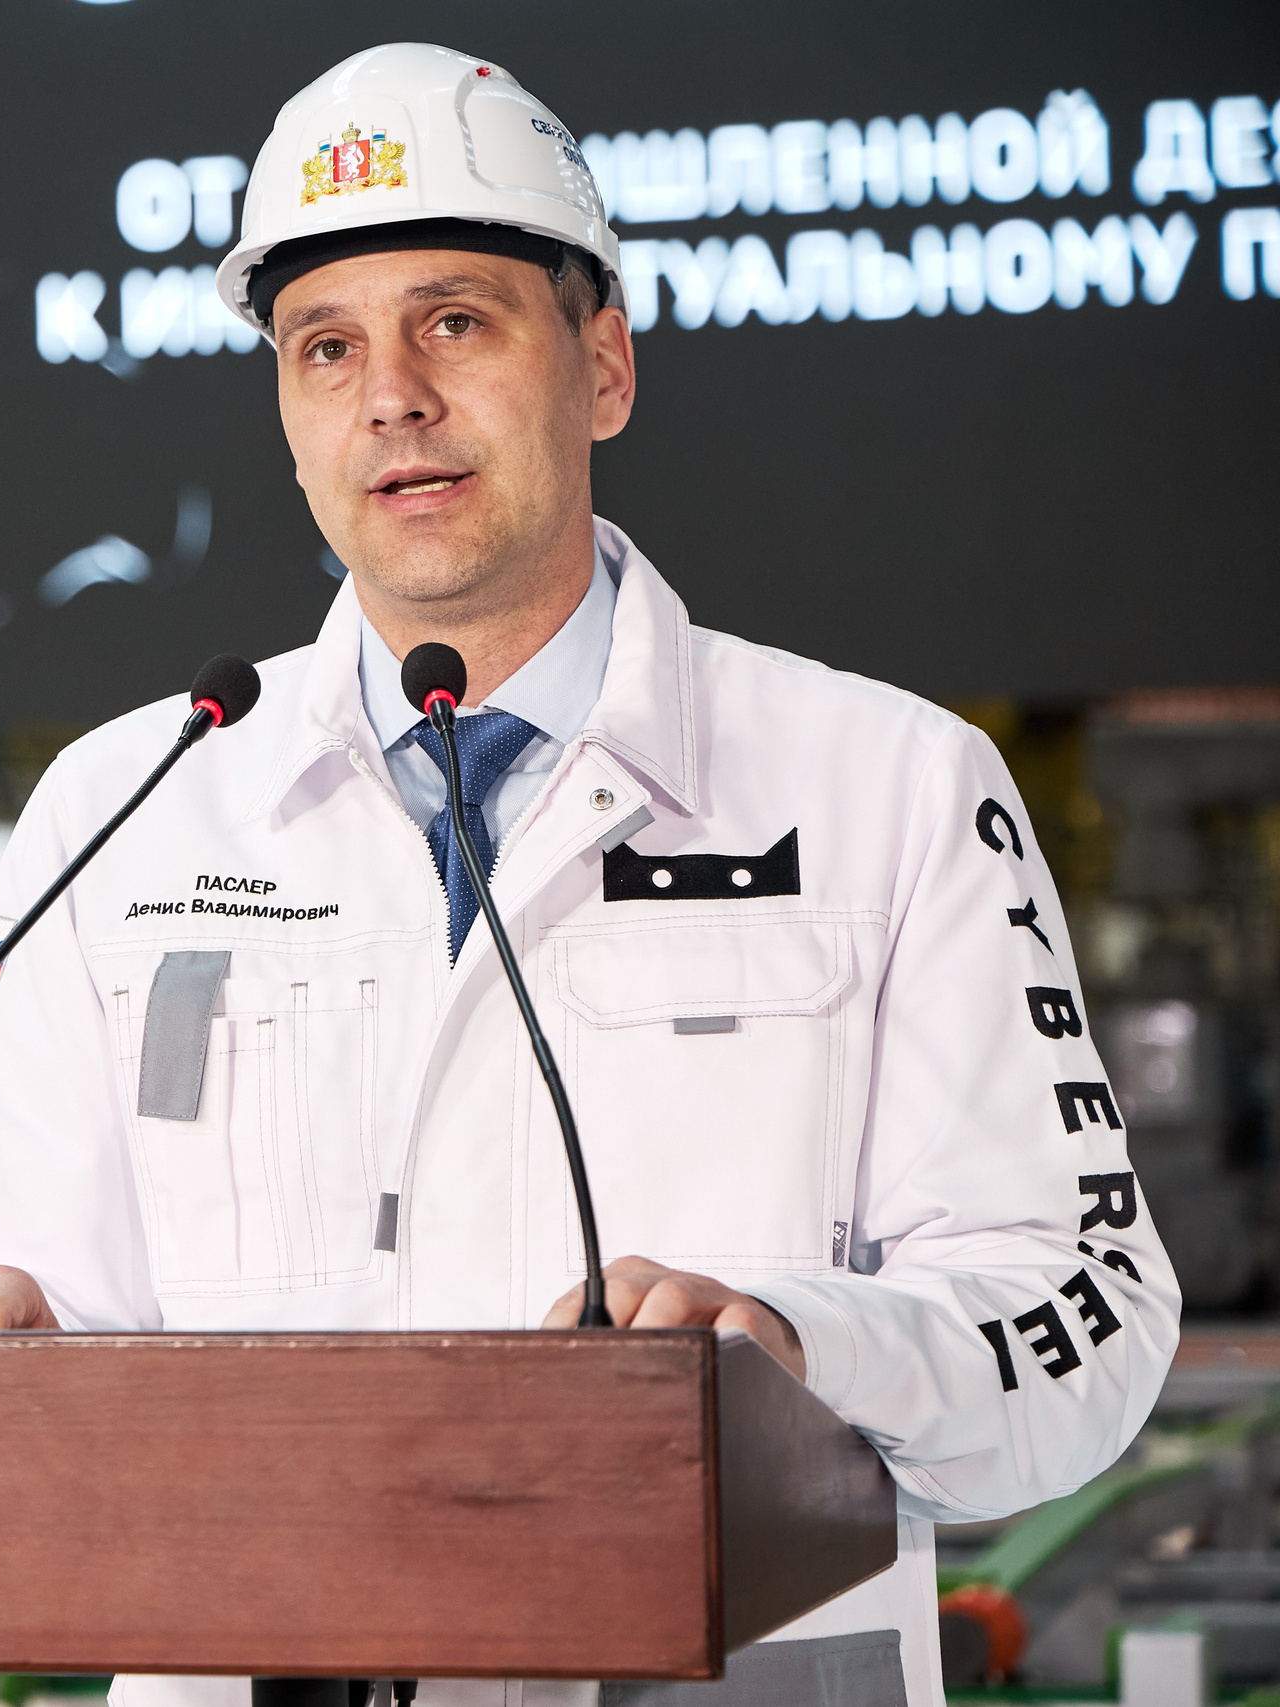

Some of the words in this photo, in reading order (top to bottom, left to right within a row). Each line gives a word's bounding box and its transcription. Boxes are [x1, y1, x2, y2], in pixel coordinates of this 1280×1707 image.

[116, 155, 249, 252] ОТ
[582, 87, 1111, 223] ШЛЕННОЙ
[1132, 95, 1280, 206] ДЕ
[36, 270, 108, 364] К
[124, 902, 185, 920] Денис
[191, 898, 339, 922] Владимирович
[195, 875, 277, 895] ПАСЛЕР
